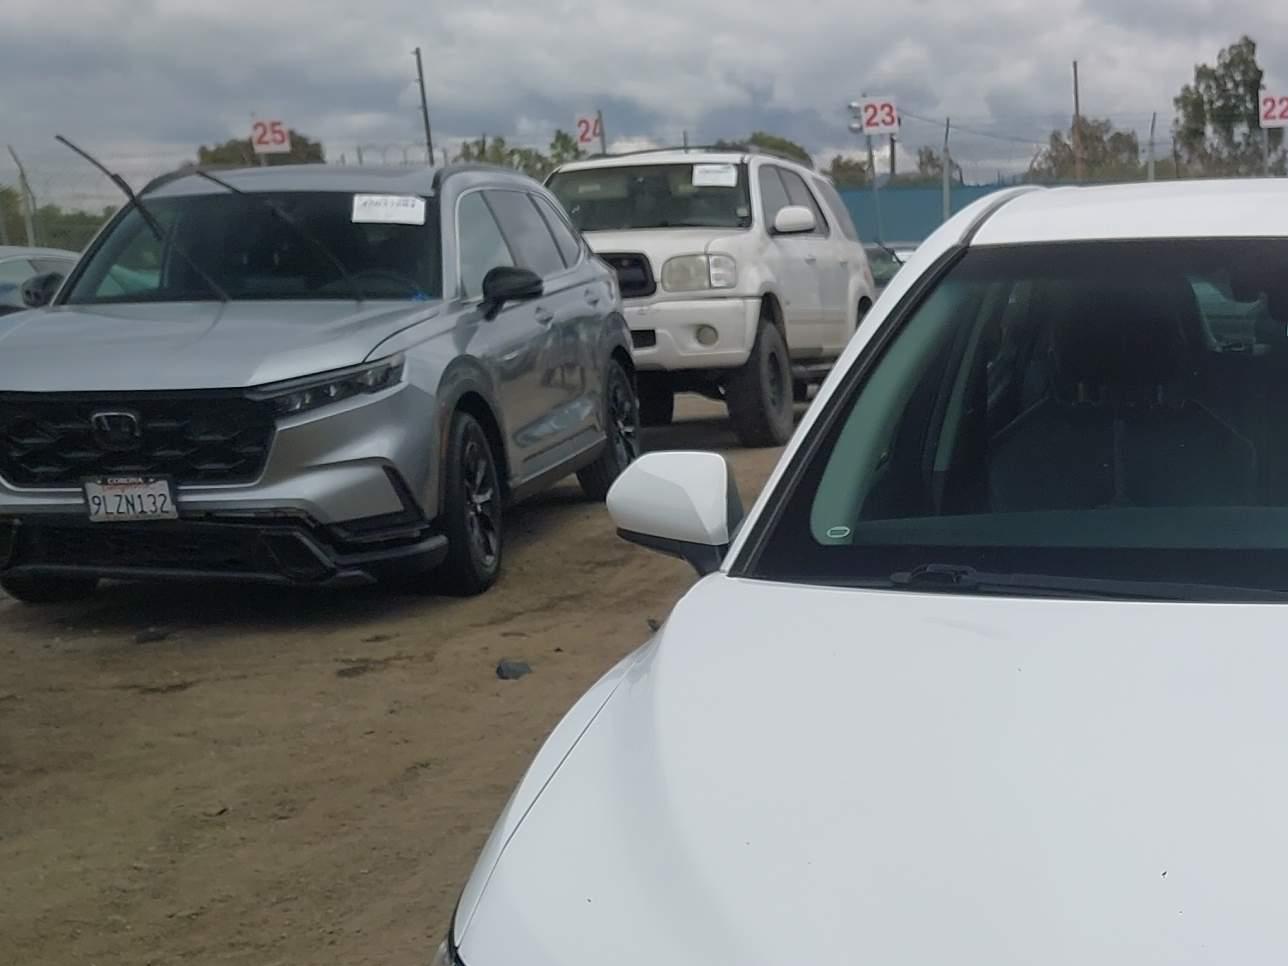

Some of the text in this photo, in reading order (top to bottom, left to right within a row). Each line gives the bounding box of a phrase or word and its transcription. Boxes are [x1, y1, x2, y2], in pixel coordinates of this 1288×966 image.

[863, 103, 895, 127] 23
[253, 121, 286, 145] 25
[91, 493, 169, 516] 9LZN132
